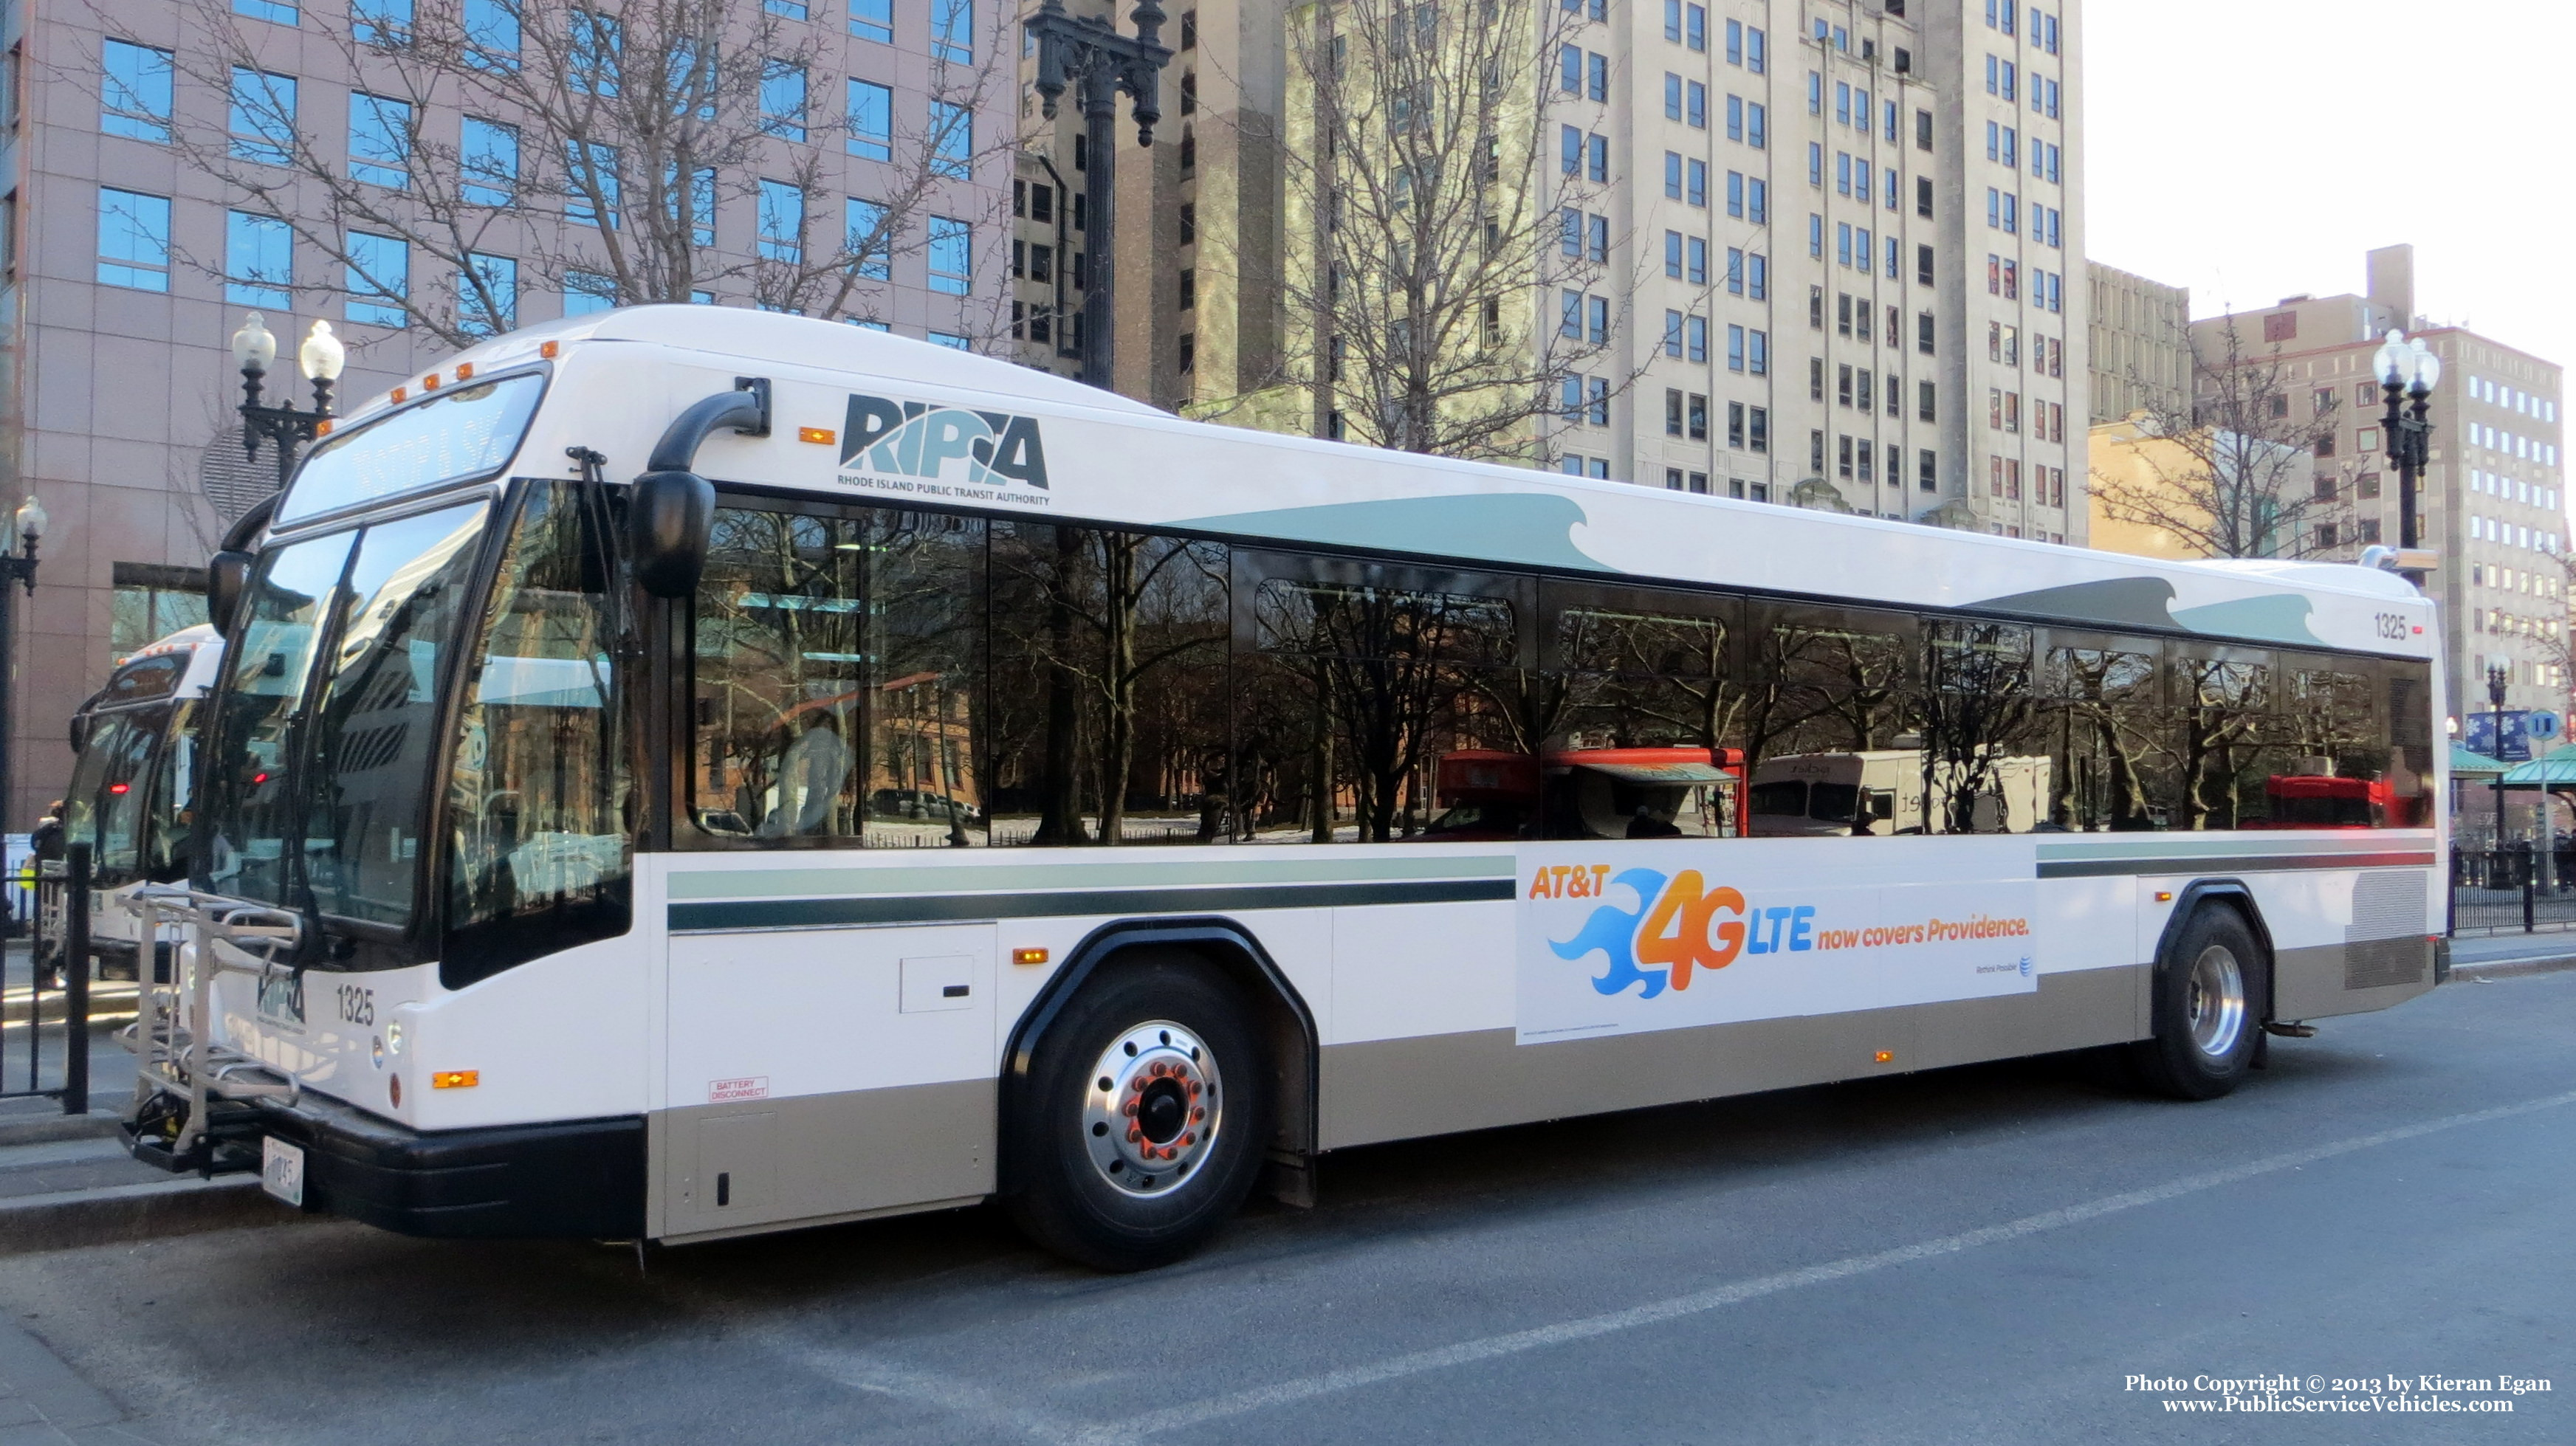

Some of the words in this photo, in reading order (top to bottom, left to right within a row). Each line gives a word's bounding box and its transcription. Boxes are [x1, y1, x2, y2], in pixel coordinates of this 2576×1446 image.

[839, 393, 1049, 490] RIPTA
[838, 475, 873, 488] RHODE
[876, 480, 914, 492] ISLAND
[917, 483, 952, 497] PUBLIC
[955, 488, 995, 501] TRANSIT
[997, 492, 1051, 506] AUTHORITY
[2374, 613, 2406, 641] 1325
[1529, 864, 1610, 900] AT&T
[1748, 906, 1816, 954] LTE
[1817, 928, 1858, 950] now
[1862, 923, 1924, 947] covers
[1927, 913, 2030, 942] Providence.
[337, 983, 374, 1027] 1325
[712, 1087, 766, 1100] DISCONNECT
[717, 1080, 755, 1090] BATTERY
